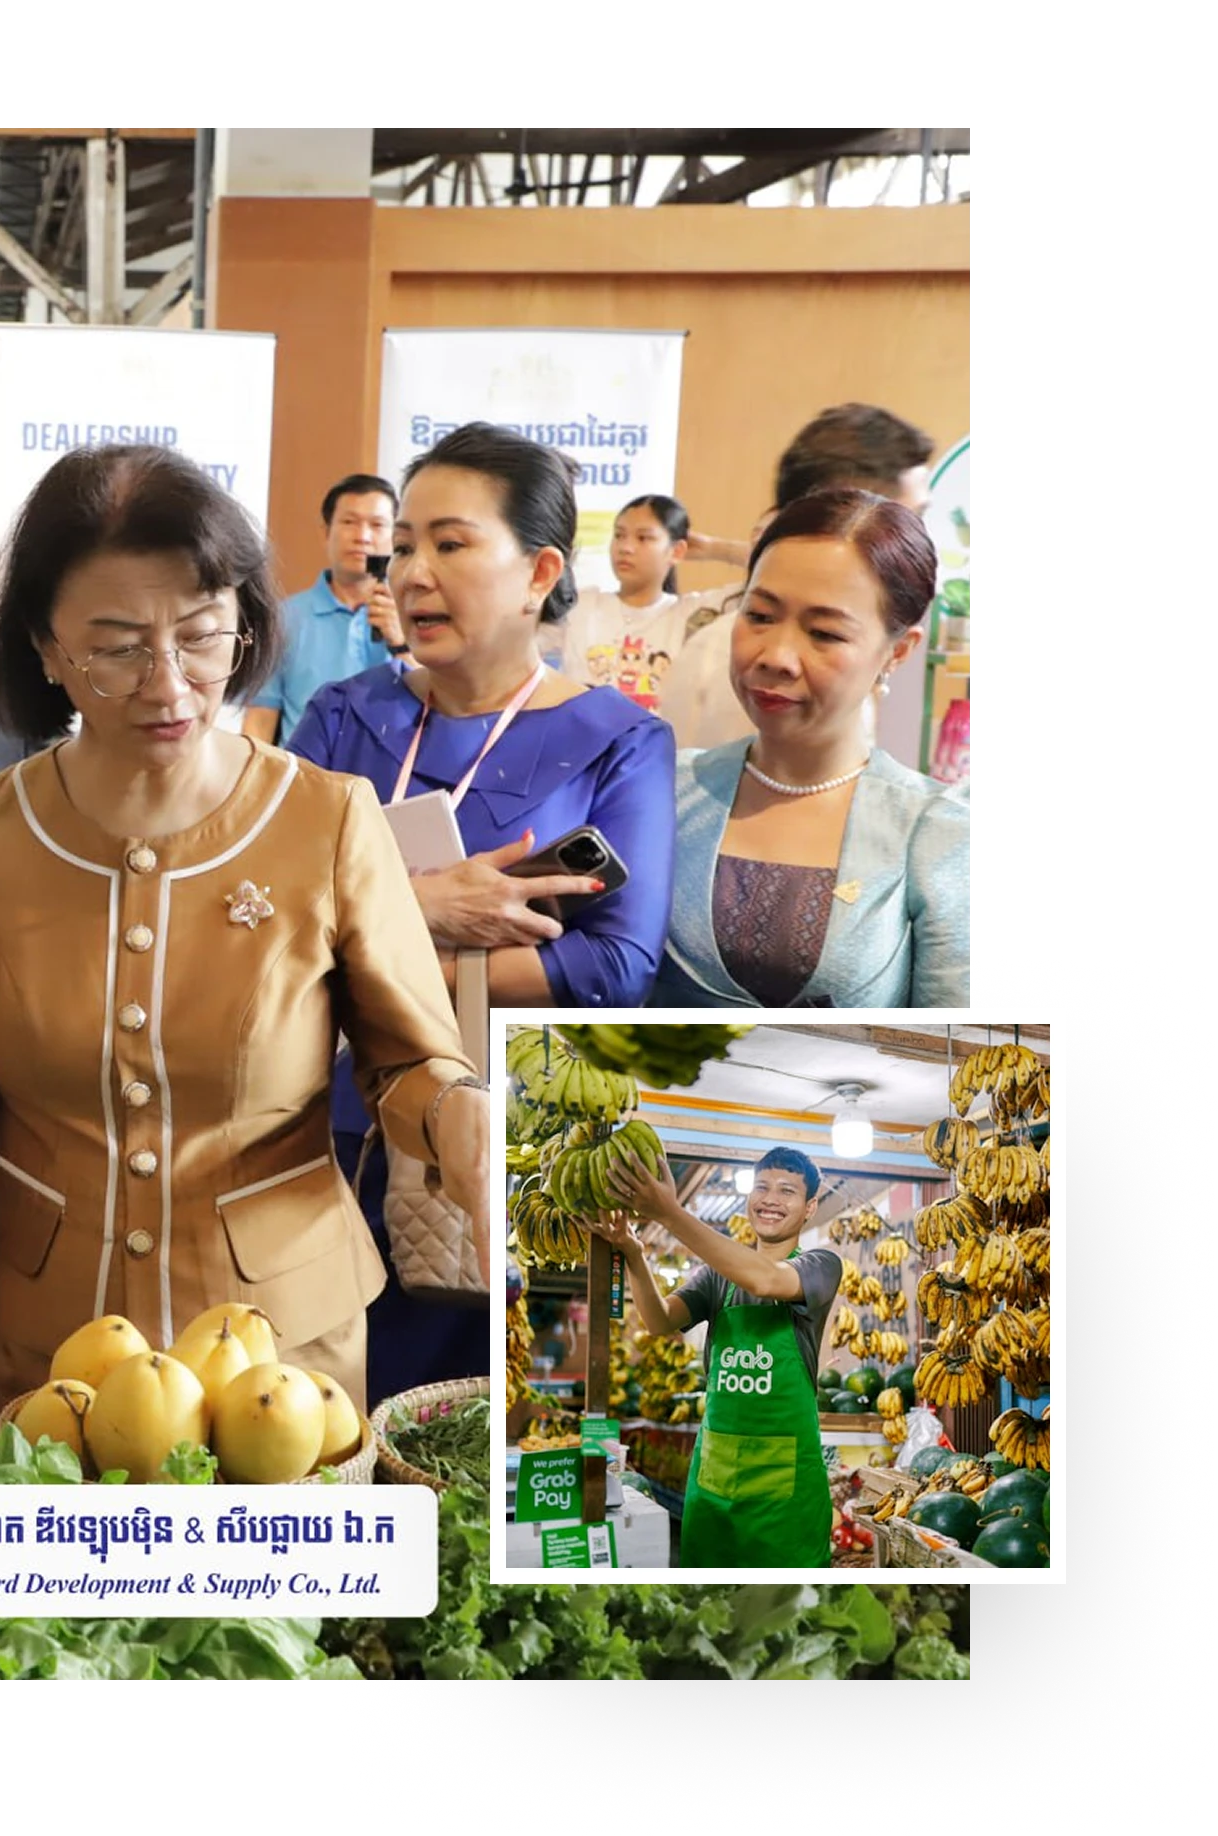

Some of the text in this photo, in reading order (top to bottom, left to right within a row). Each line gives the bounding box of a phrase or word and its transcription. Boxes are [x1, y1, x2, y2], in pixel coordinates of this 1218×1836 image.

[22, 421, 178, 451] DEALERSHIP
[720, 1344, 774, 1370] Grab
[717, 1370, 772, 1395] Food
[533, 1457, 576, 1468] We prefer
[530, 1469, 577, 1489] Grab
[534, 1490, 571, 1510] Pay
